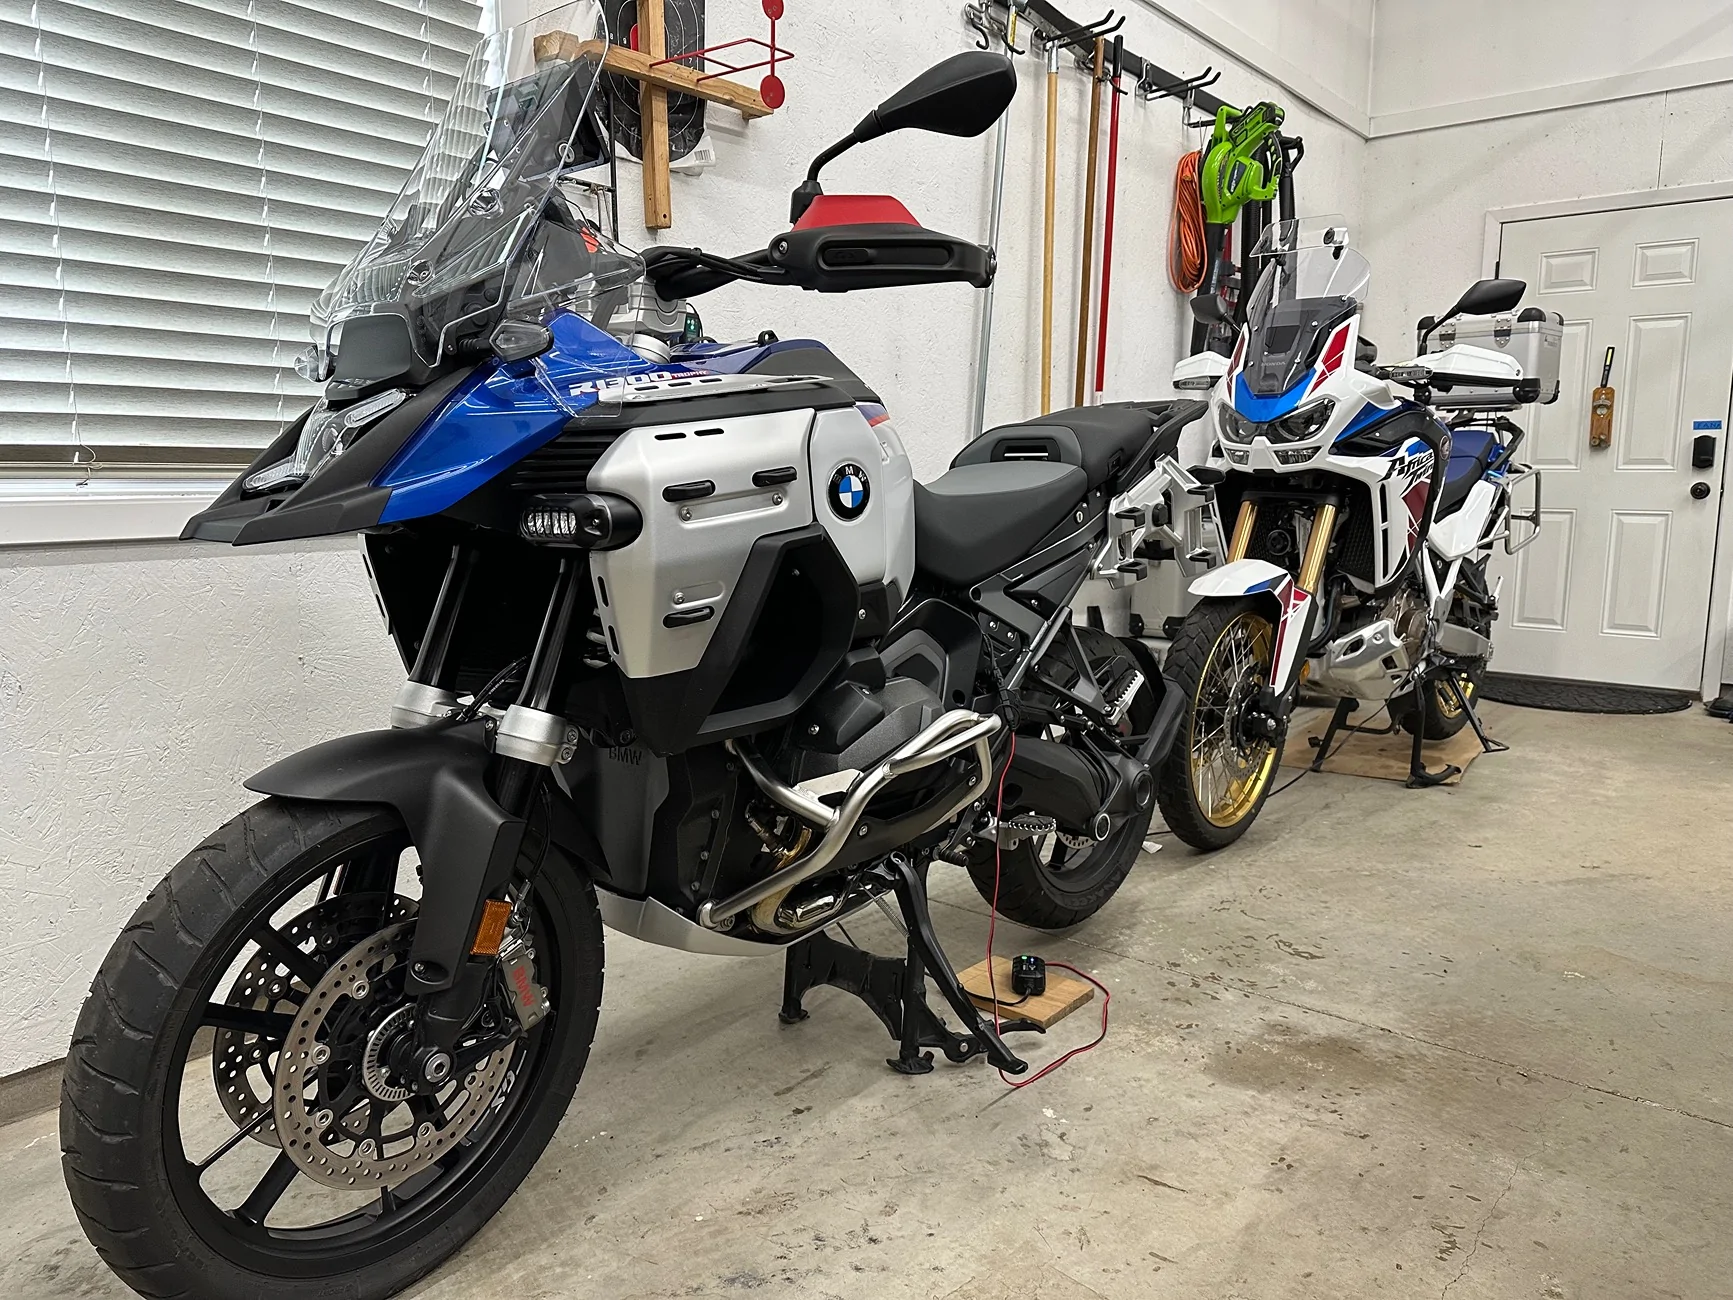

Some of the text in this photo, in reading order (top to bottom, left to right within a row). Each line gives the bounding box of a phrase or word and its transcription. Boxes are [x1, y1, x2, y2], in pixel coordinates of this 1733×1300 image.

[568, 371, 673, 396] R1300
[833, 465, 867, 484] BMW
[1376, 451, 1434, 484] Africa
[608, 747, 643, 766] BMW
[513, 965, 536, 1007] BMW
